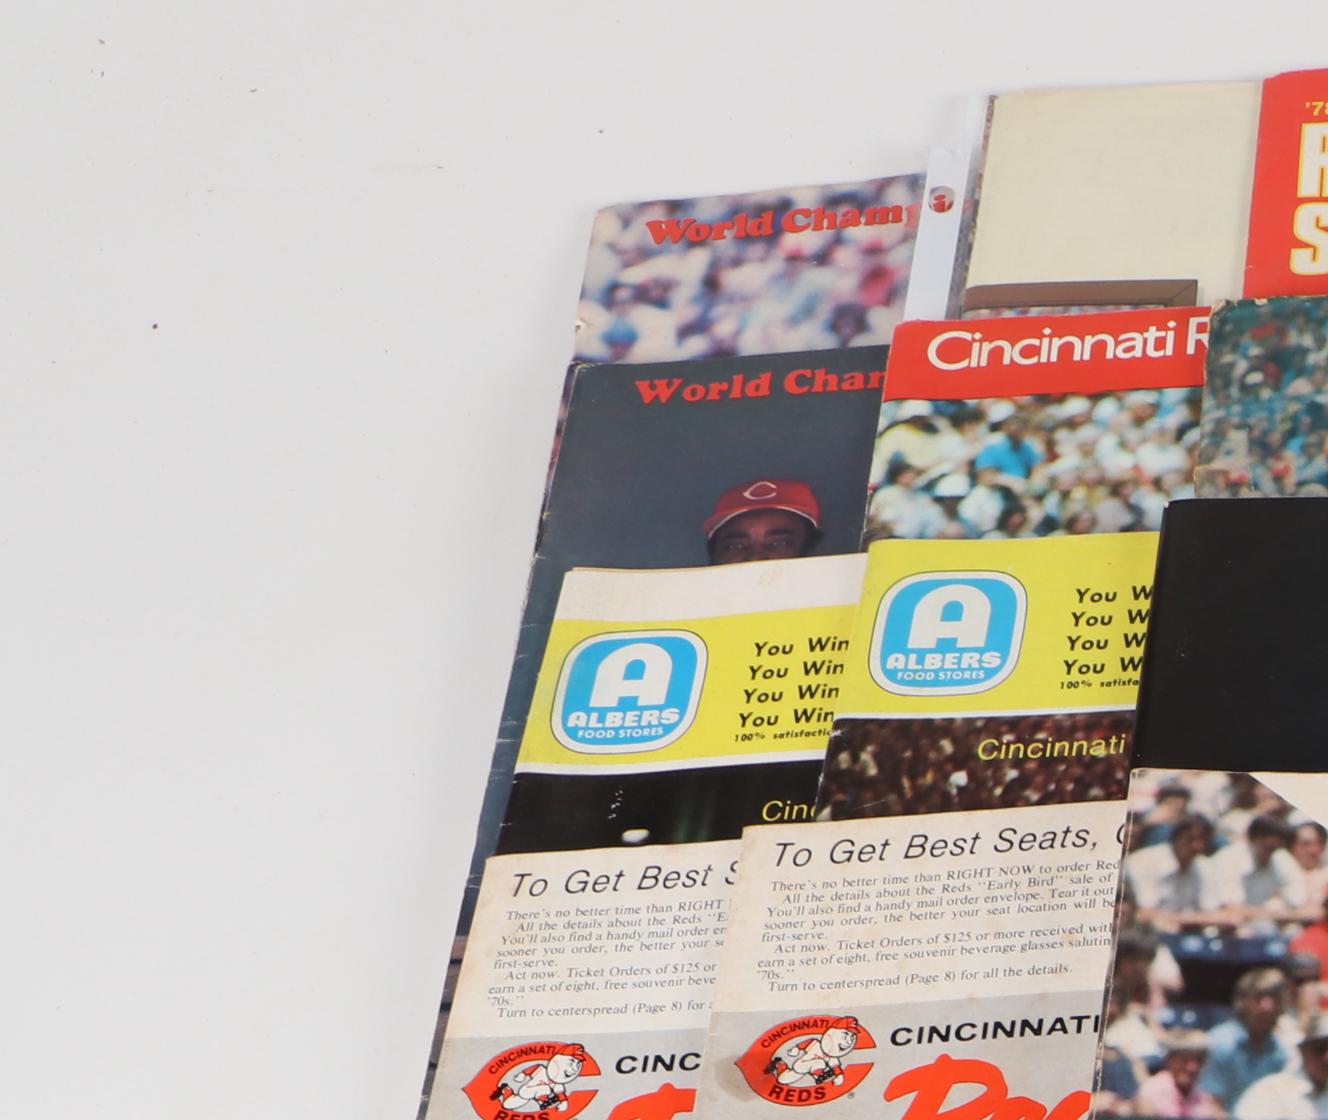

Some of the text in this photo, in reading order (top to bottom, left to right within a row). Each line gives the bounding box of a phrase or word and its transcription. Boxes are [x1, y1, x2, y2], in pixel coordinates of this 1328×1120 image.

[646, 210, 774, 244] World
[927, 320, 1176, 371] Cincinnati
[635, 372, 772, 404] World
[754, 637, 849, 657] You Win
[886, 652, 1002, 670] ALBERS
[897, 670, 985, 681] FOOD STORES
[567, 708, 680, 728] ALBERS
[577, 726, 664, 739] FOOD STORES
[978, 734, 1126, 761] Cincinnati
[774, 825, 1098, 868] To Get Best Seats,
[772, 864, 1036, 893] There's no better time than RIGHT NOW
[768, 1083, 827, 1103] REDS
